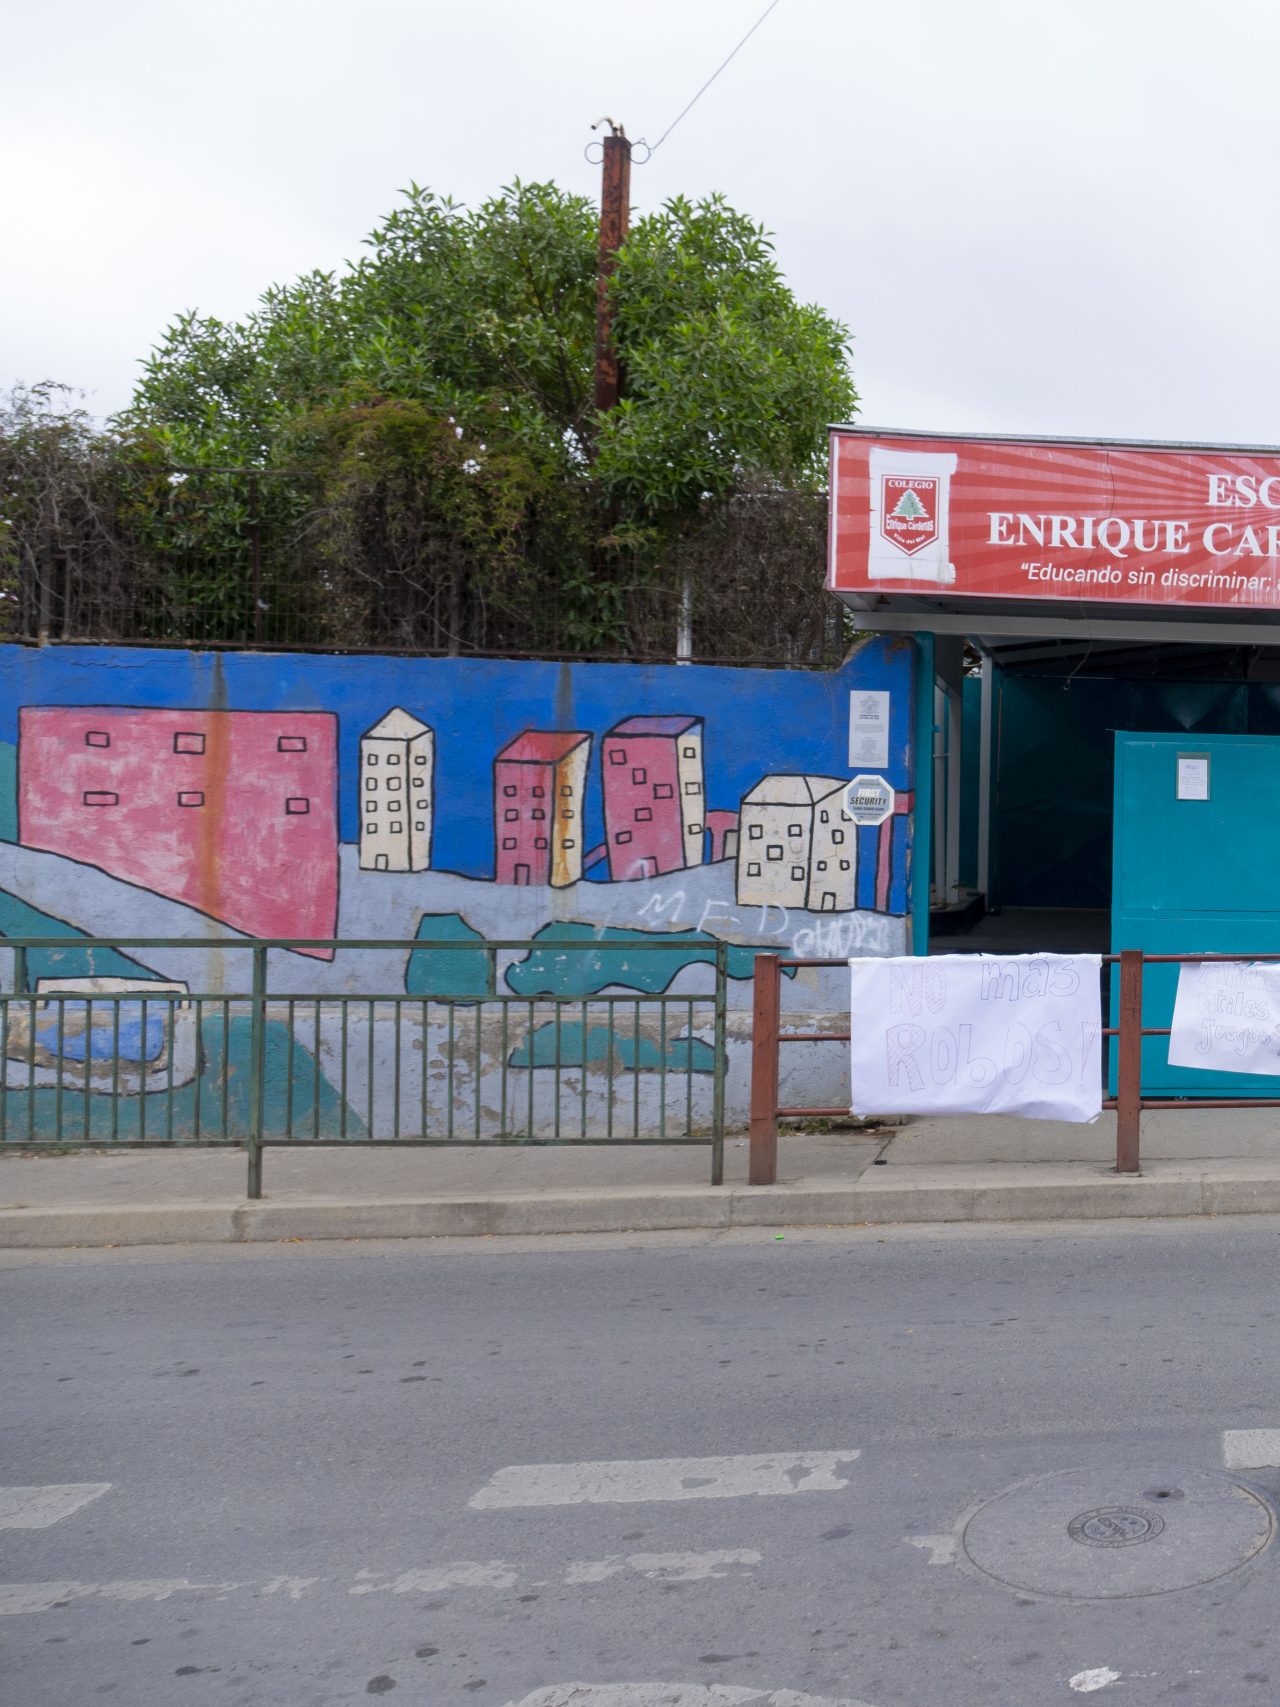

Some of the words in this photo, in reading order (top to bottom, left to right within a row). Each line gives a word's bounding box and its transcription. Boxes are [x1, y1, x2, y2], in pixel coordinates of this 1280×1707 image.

[888, 479, 933, 489] COLEGIO
[986, 512, 1190, 559] ENRIQUE
[1128, 569, 1155, 584] sin
[850, 796, 887, 806] SECURITY
[890, 962, 947, 1017] NO
